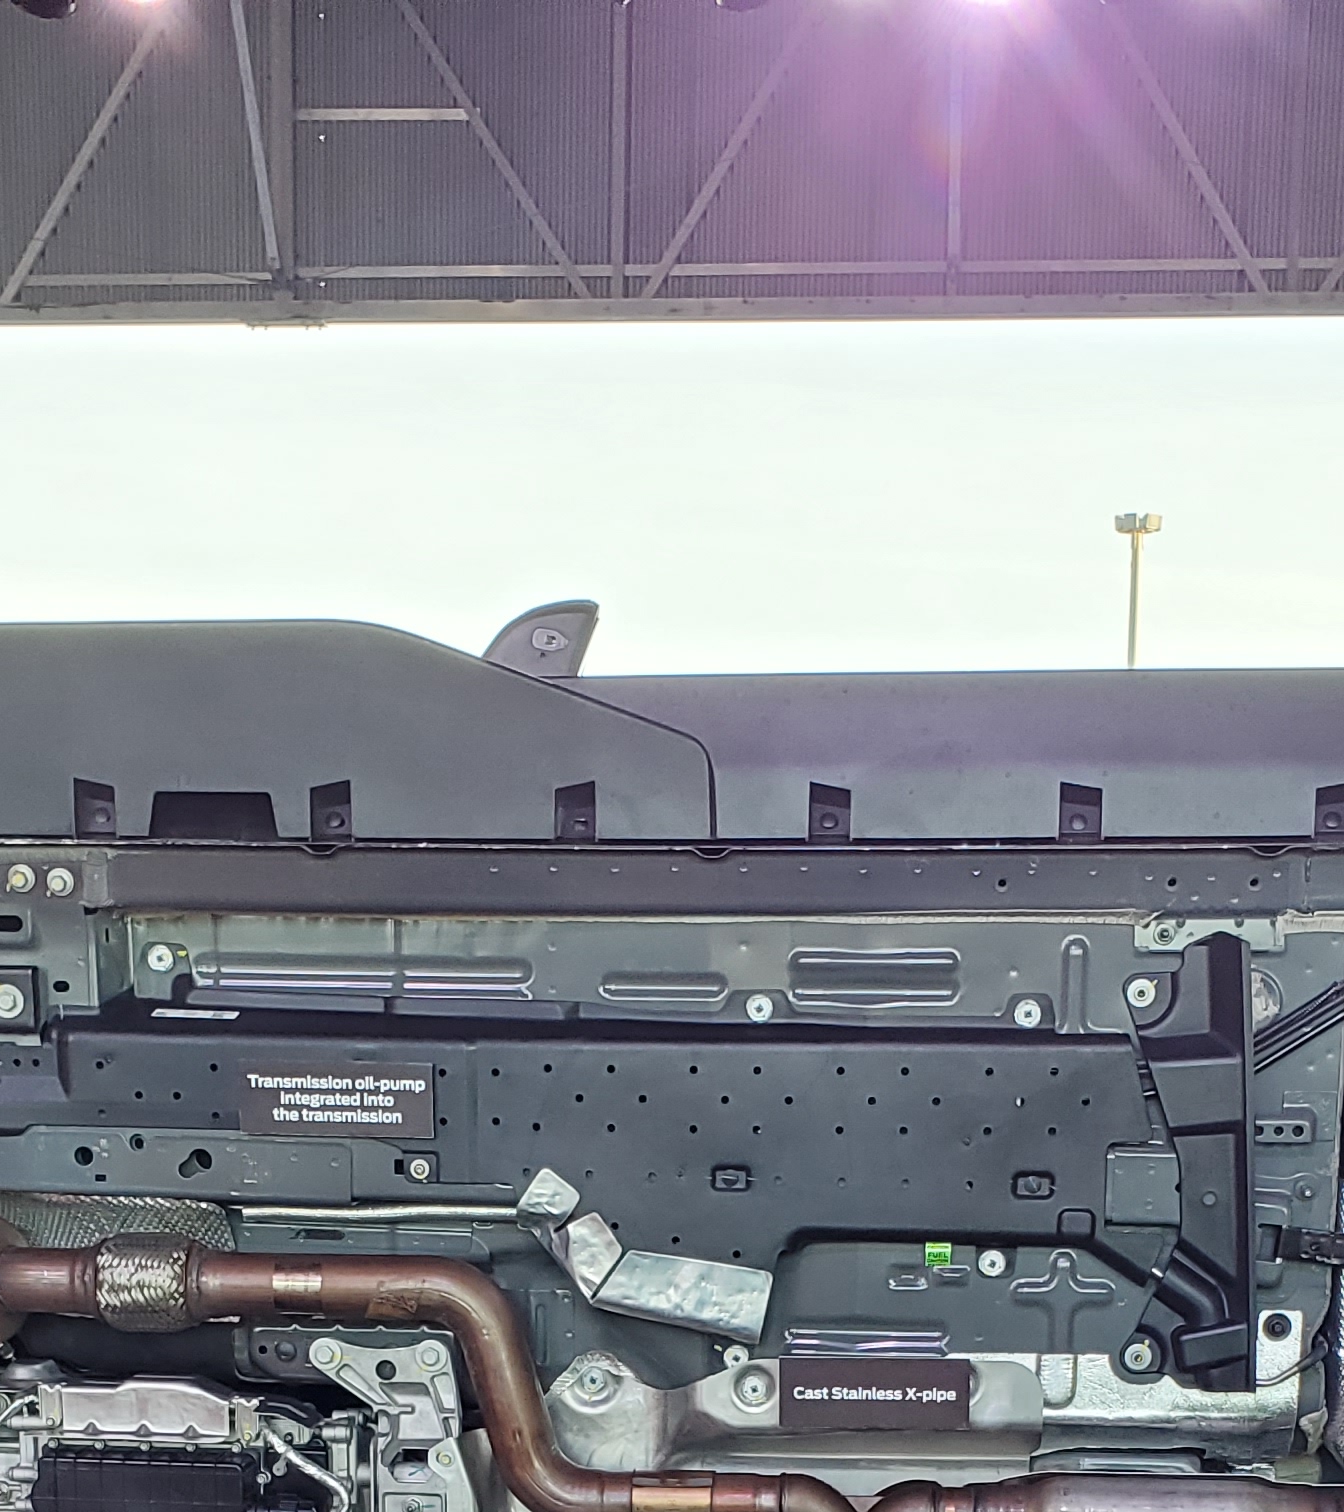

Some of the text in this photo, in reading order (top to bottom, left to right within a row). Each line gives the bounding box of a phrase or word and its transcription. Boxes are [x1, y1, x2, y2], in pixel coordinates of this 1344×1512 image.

[247, 1074, 425, 1093] Transmission oil-pump
[281, 1091, 394, 1107] integrated into
[272, 1107, 402, 1123] the transmission
[794, 1387, 956, 1403] Cast Stainless X-pipe
